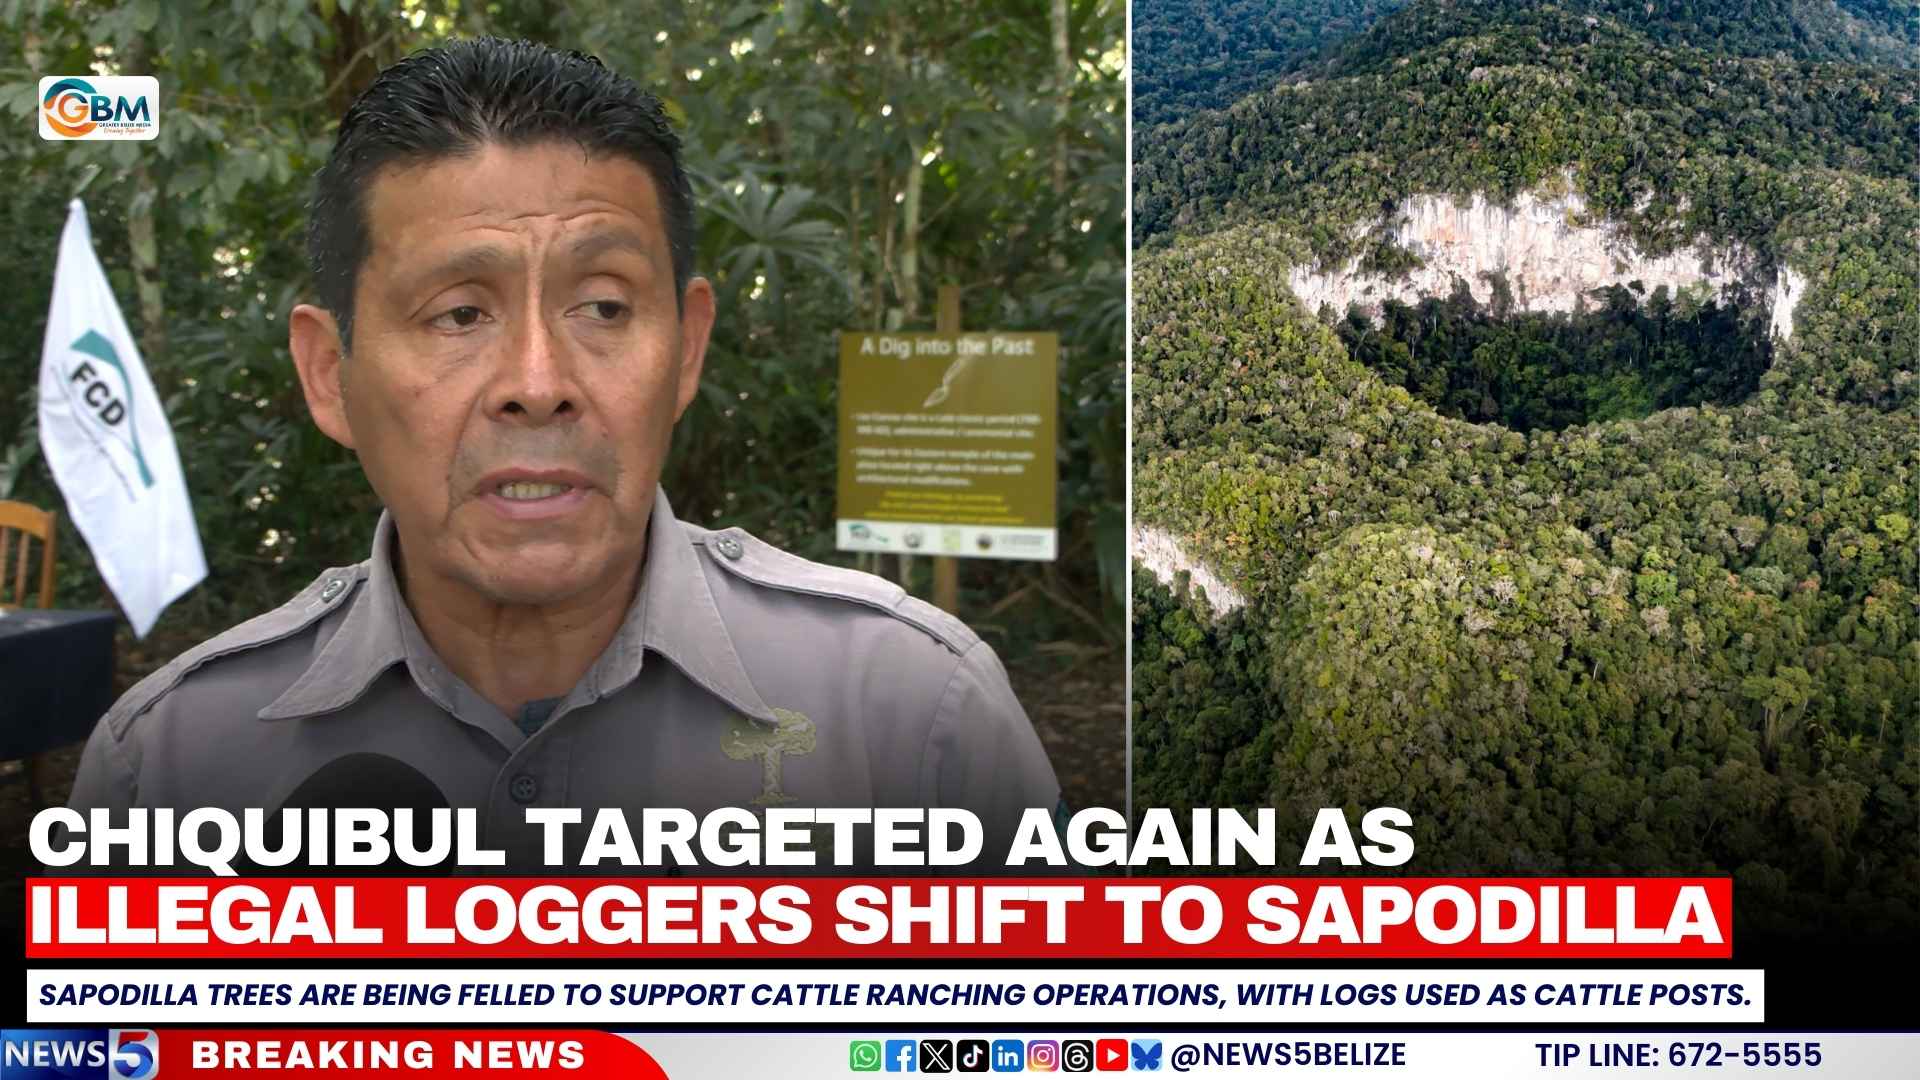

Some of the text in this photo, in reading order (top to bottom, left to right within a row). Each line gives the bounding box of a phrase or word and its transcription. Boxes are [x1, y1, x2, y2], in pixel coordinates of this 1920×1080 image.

[861, 336, 1035, 359] A Dig into the Past
[70, 361, 125, 426] FCD
